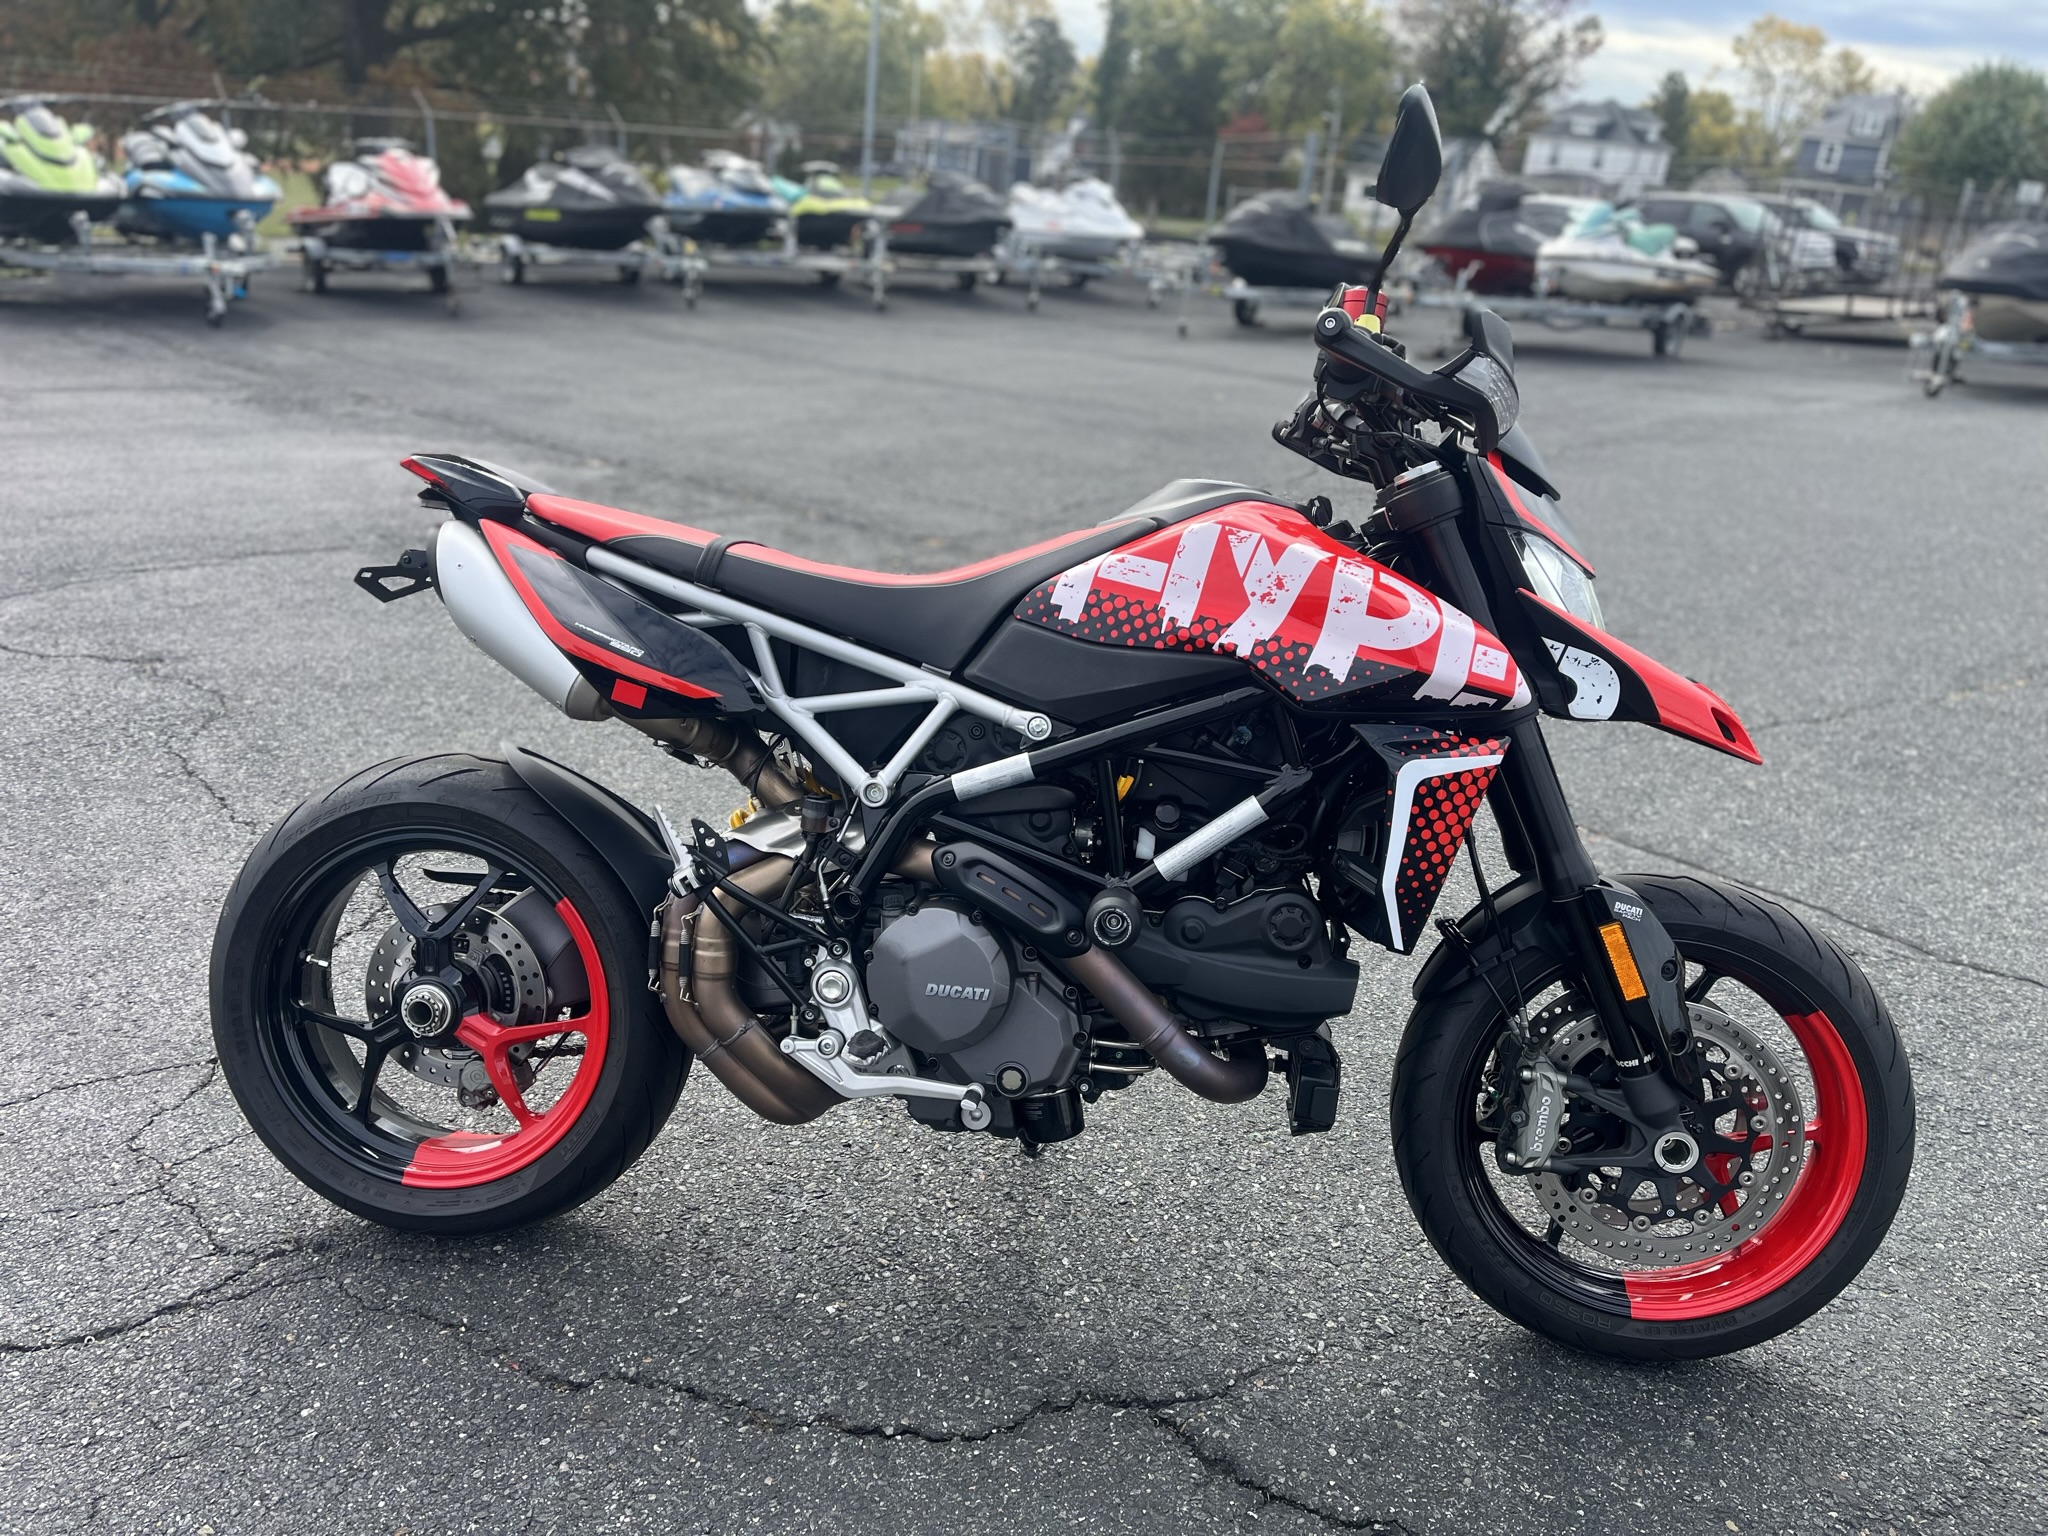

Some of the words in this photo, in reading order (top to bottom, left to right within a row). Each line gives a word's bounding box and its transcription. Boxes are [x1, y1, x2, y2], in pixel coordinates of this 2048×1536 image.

[1614, 901, 1643, 915] DUCATI
[925, 983, 990, 1001] DUCATI
[1530, 1096, 1551, 1153] brembo
[1538, 1291, 1612, 1330] ROSSO
